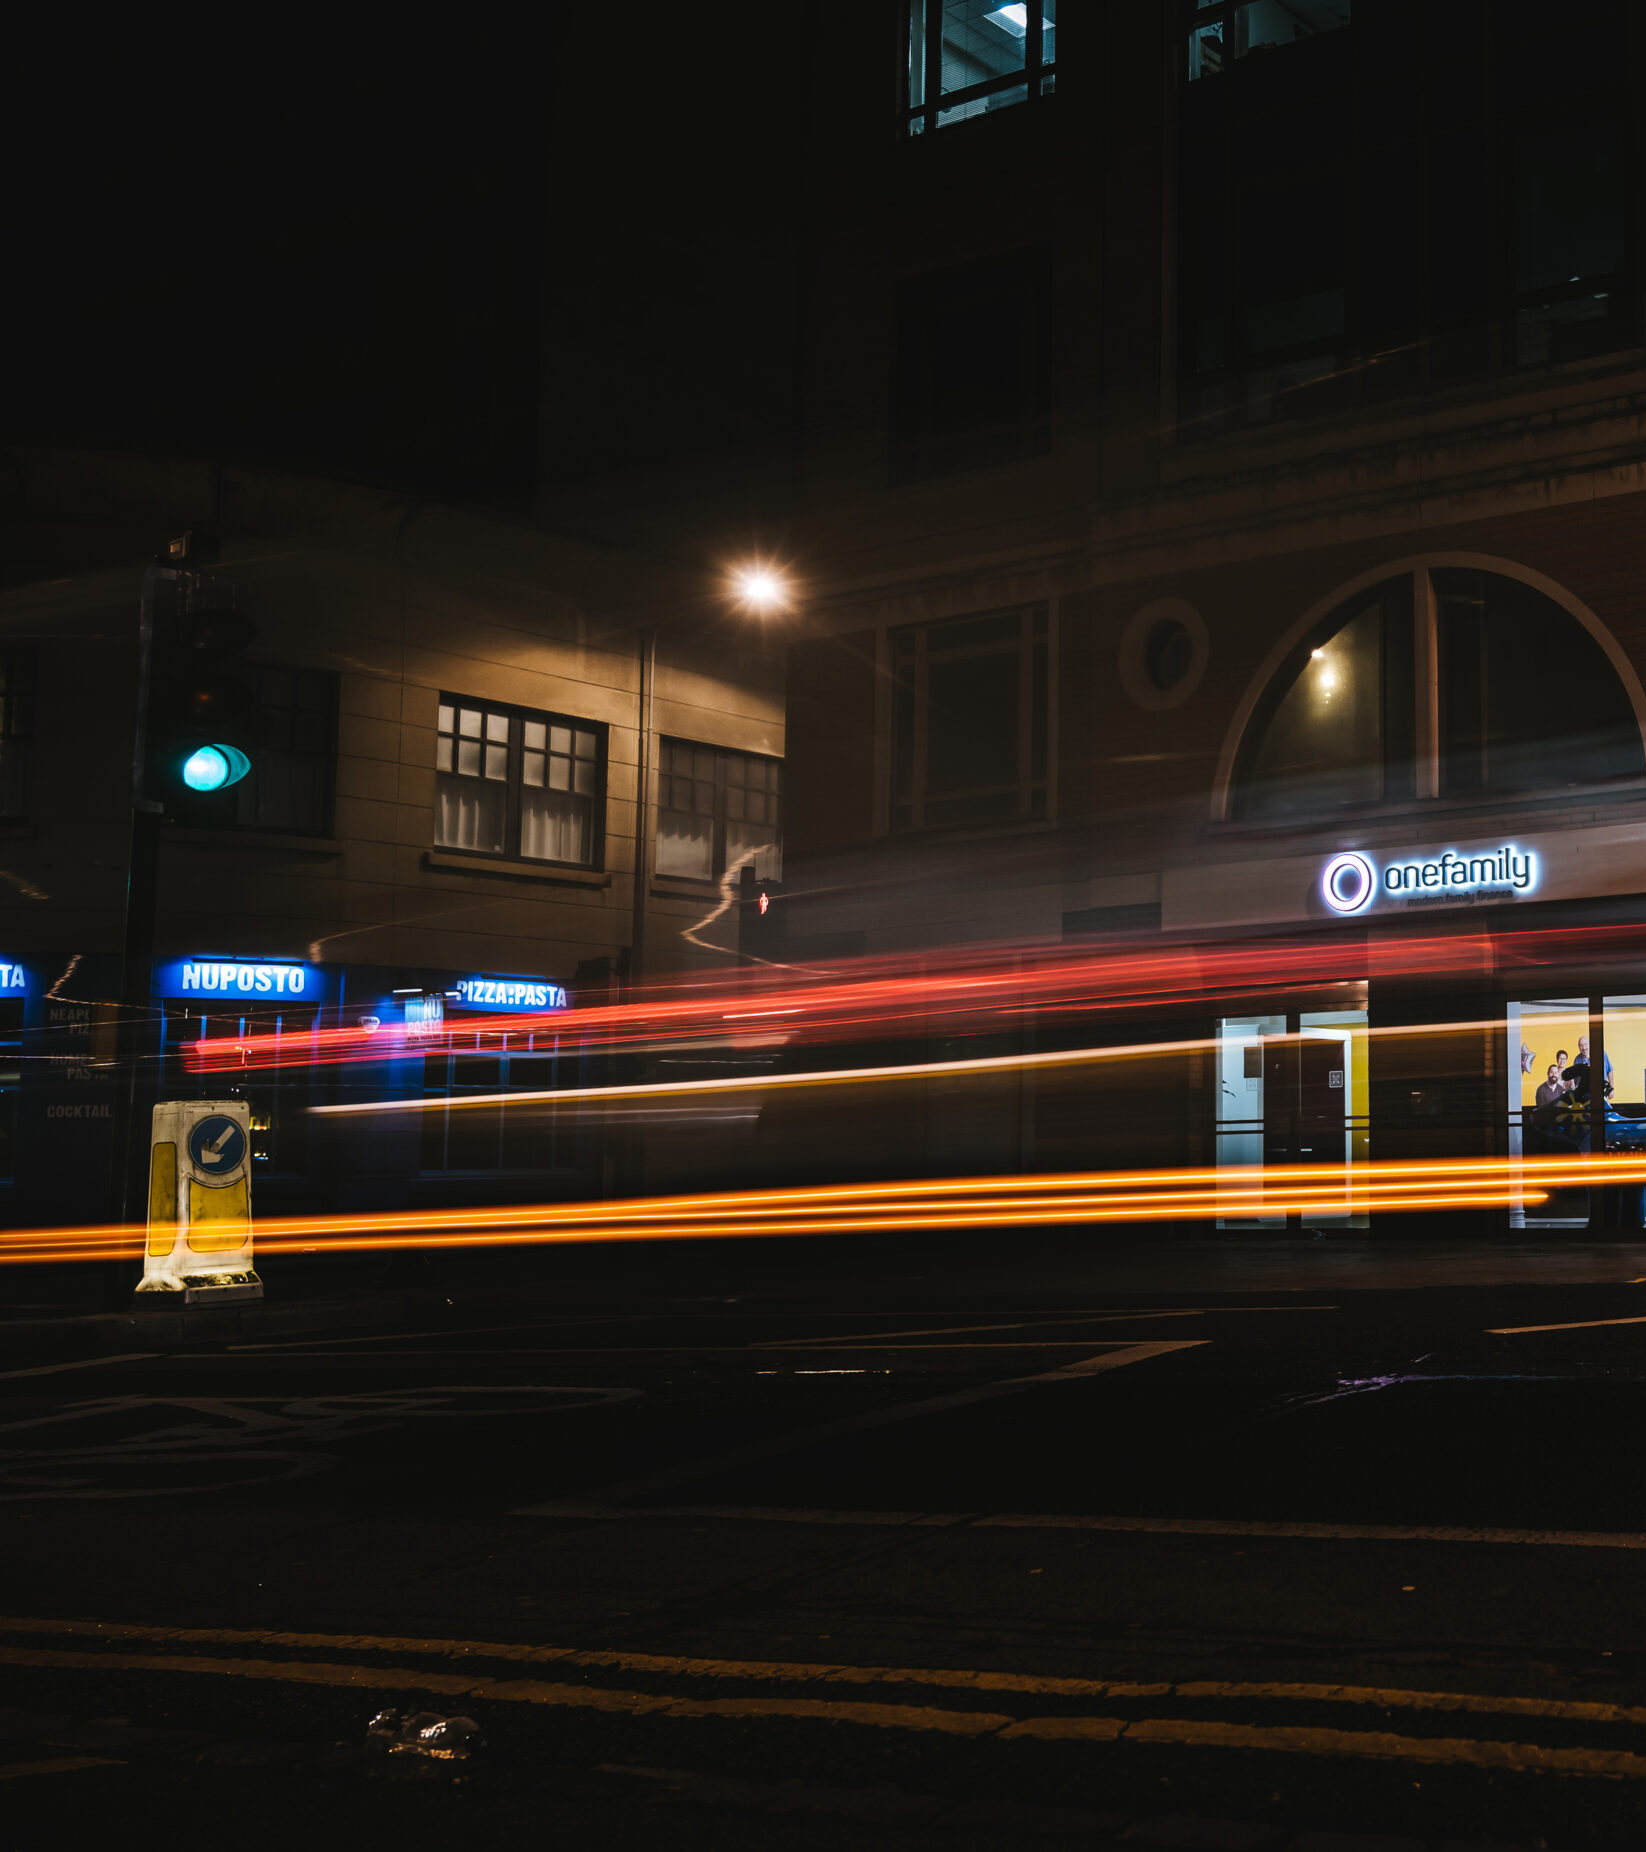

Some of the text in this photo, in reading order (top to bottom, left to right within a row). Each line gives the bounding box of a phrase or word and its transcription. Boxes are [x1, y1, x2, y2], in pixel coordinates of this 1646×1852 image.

[1385, 848, 1531, 890] onefamily
[182, 964, 305, 993] NUPOSTO
[457, 980, 567, 1007] PIZZA:PASTA
